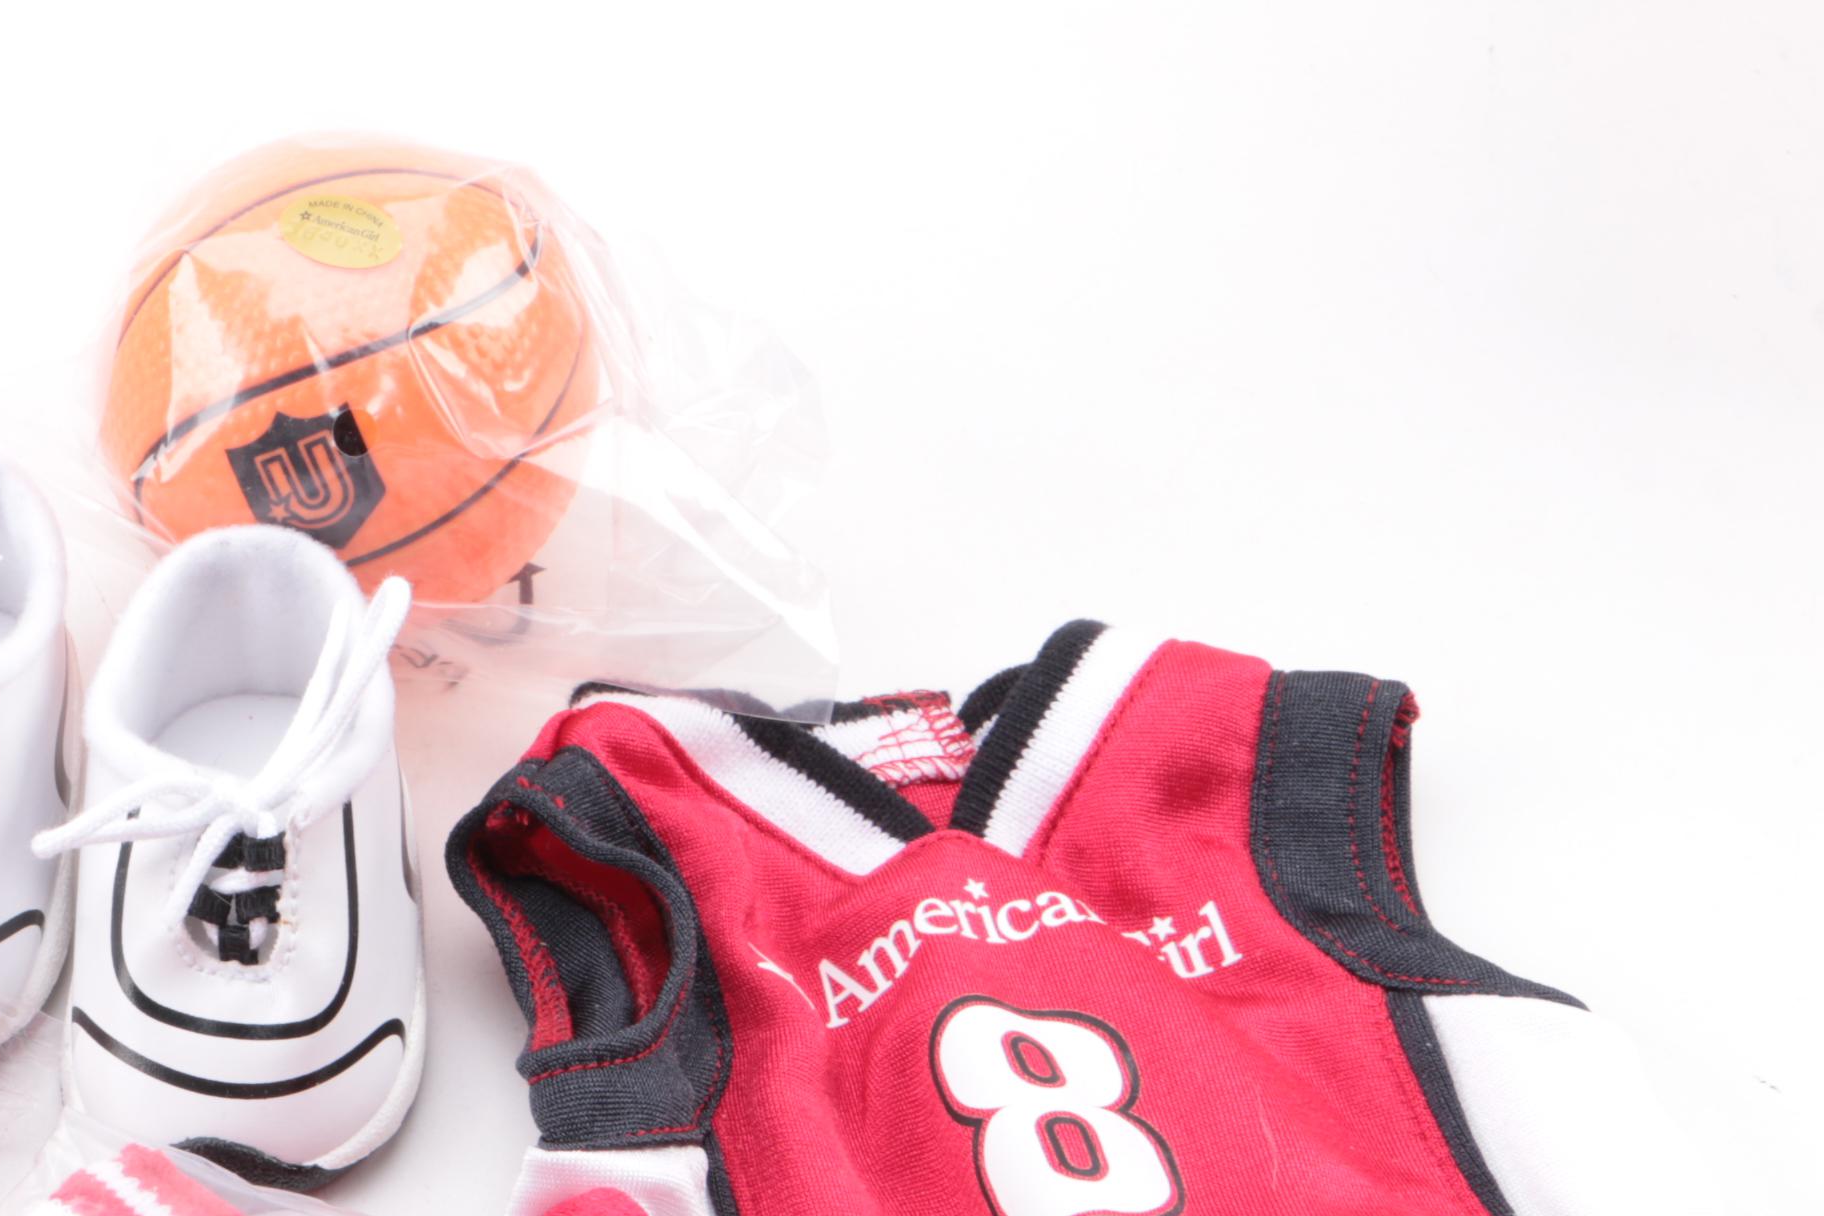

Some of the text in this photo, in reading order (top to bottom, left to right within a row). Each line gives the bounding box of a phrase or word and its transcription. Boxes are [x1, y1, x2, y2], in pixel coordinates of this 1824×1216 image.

[308, 199, 340, 209] MADE
[343, 202, 355, 212] IN
[819, 877, 1244, 1030] America irl
